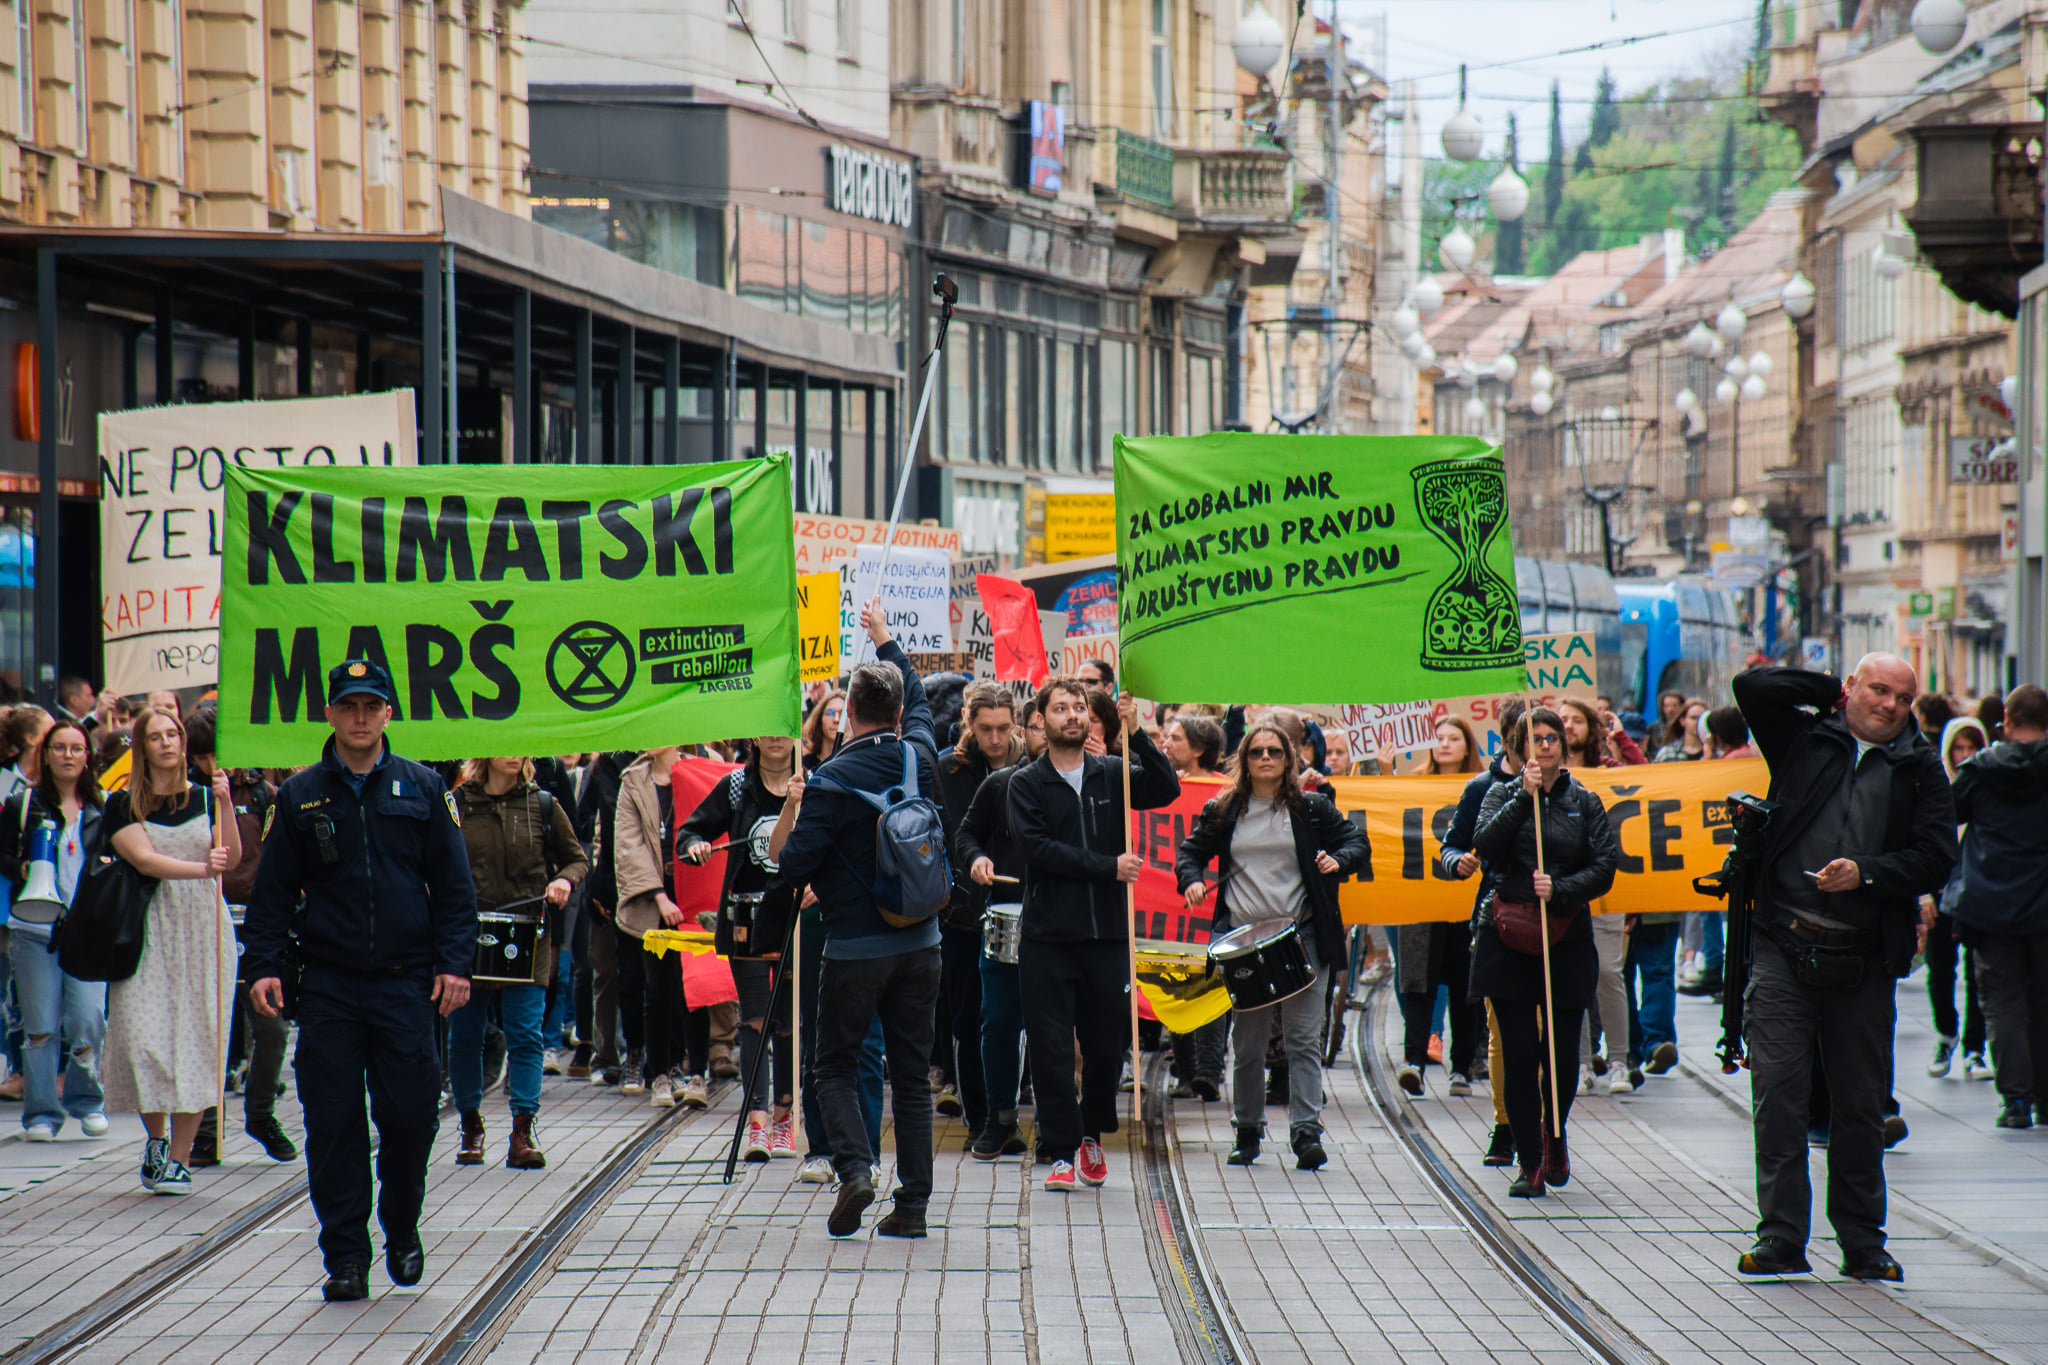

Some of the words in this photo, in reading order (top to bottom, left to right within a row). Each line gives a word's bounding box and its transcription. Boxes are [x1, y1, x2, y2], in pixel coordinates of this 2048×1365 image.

[100, 448, 150, 501] NE
[1129, 509, 1153, 540] ZA
[1159, 480, 1271, 529] GLOBALNI
[1283, 471, 1340, 502] MIR
[247, 486, 735, 585] KLIMATSKI
[1132, 523, 1270, 581] KLIMATSKU
[1281, 502, 1395, 546] PRAVDU
[882, 584, 945, 600] TRATEGIJA
[1136, 565, 1273, 619] DRUŠTVENU
[1284, 544, 1401, 588] PRAVDU
[885, 609, 919, 628] LIMO
[645, 627, 735, 653] extinction
[1063, 640, 1116, 676] DIMO
[250, 600, 521, 724] MARŠ
[673, 651, 748, 678] rebellion
[910, 653, 955, 671] RIJEME
[697, 676, 754, 694] ZAGREB
[1347, 712, 1437, 757] REVOLUTION
